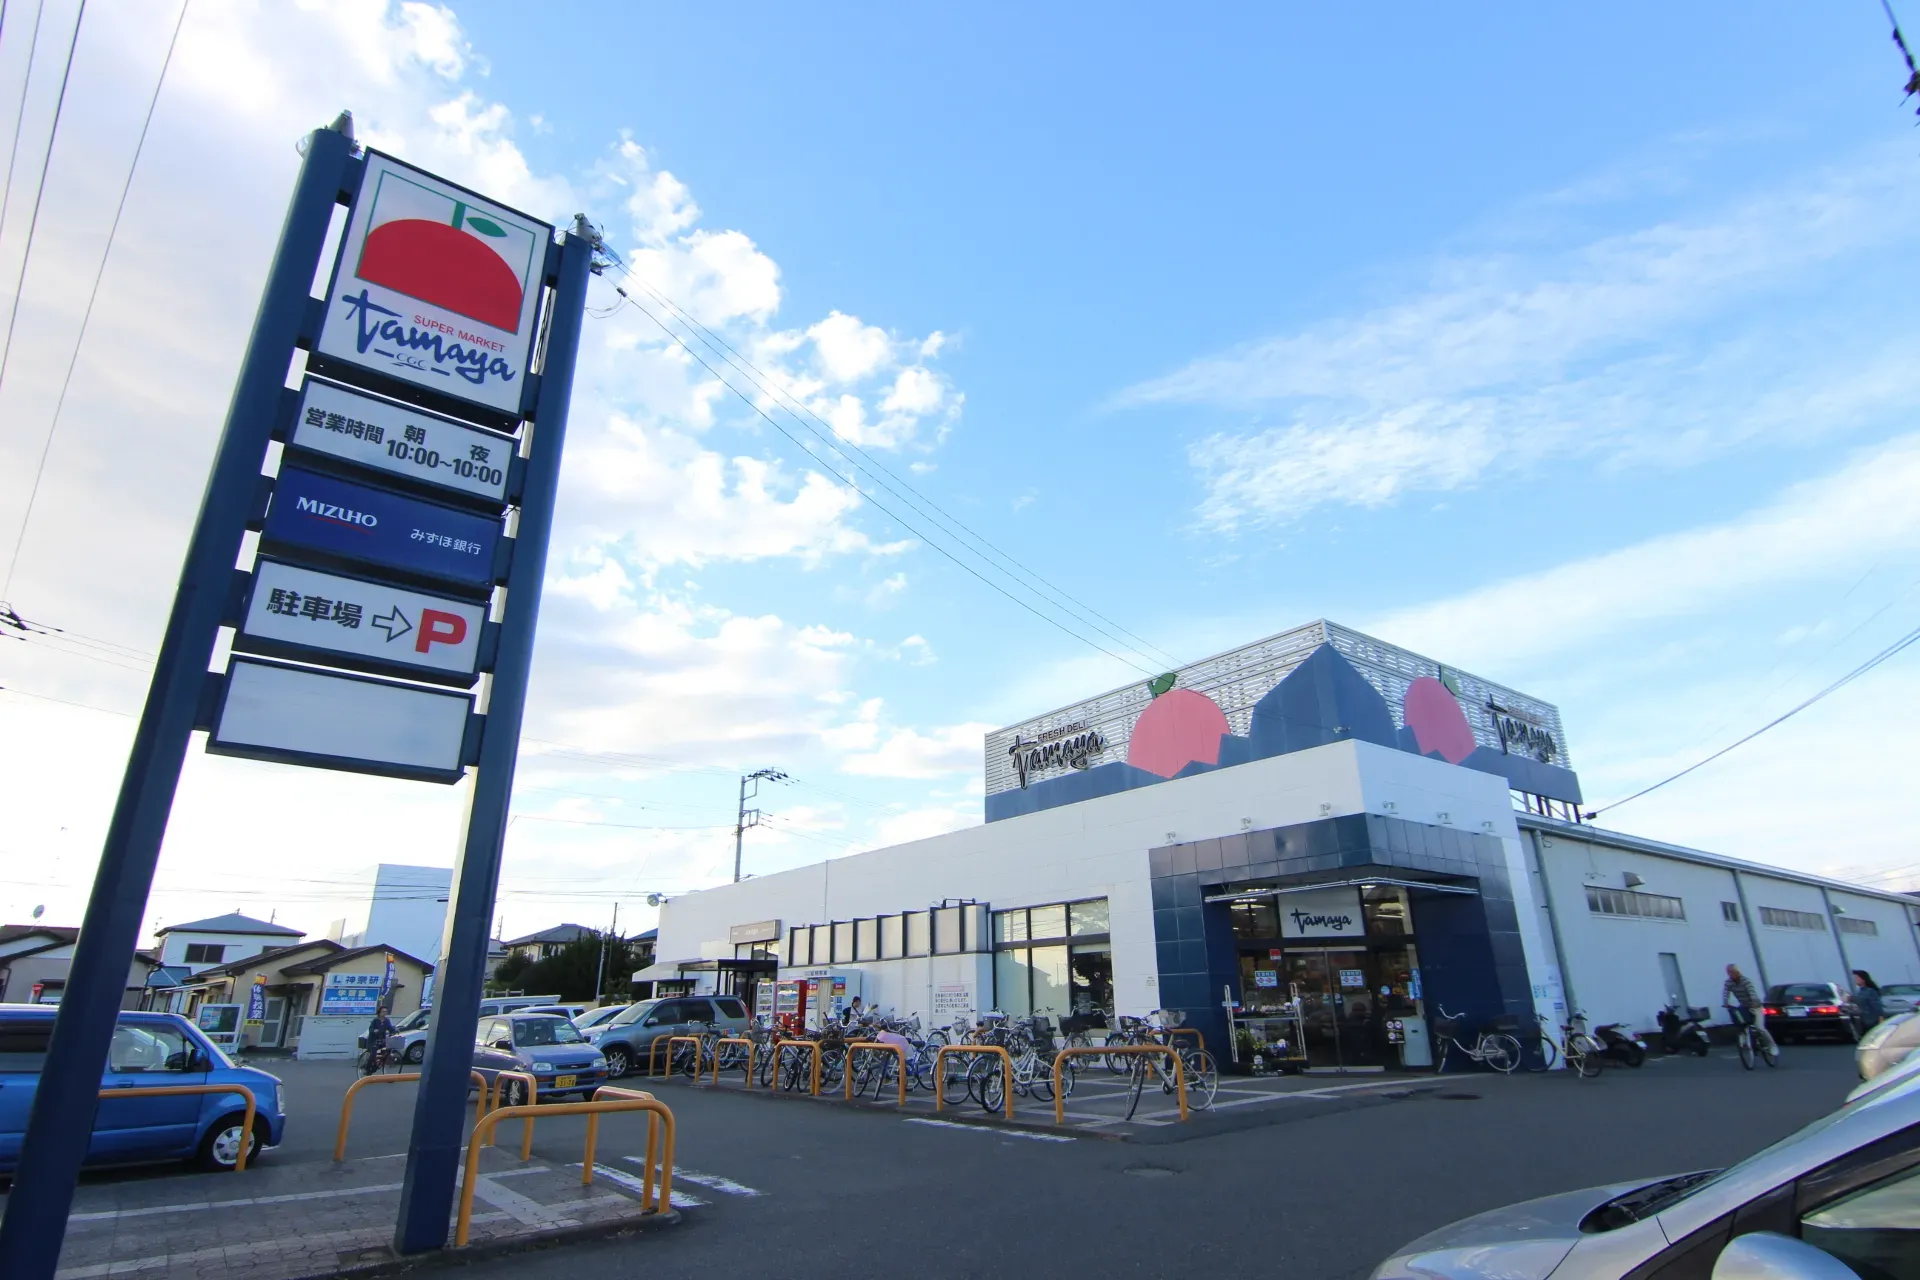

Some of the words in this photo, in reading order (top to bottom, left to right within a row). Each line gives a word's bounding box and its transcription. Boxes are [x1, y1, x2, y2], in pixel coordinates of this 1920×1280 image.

[413, 314, 454, 336] SUPER
[458, 329, 505, 353] MARKET
[396, 352, 429, 369] CGC
[305, 407, 385, 444] 営業時間
[403, 424, 427, 446] 朝
[469, 444, 491, 464] 夜
[296, 496, 378, 527] MIZUHO
[410, 528, 482, 555] みずほ銀行
[266, 588, 363, 629] 駐車場
[415, 607, 467, 653] P
[1037, 726, 1065, 742] FRESH
[1067, 719, 1087, 732] DELI
